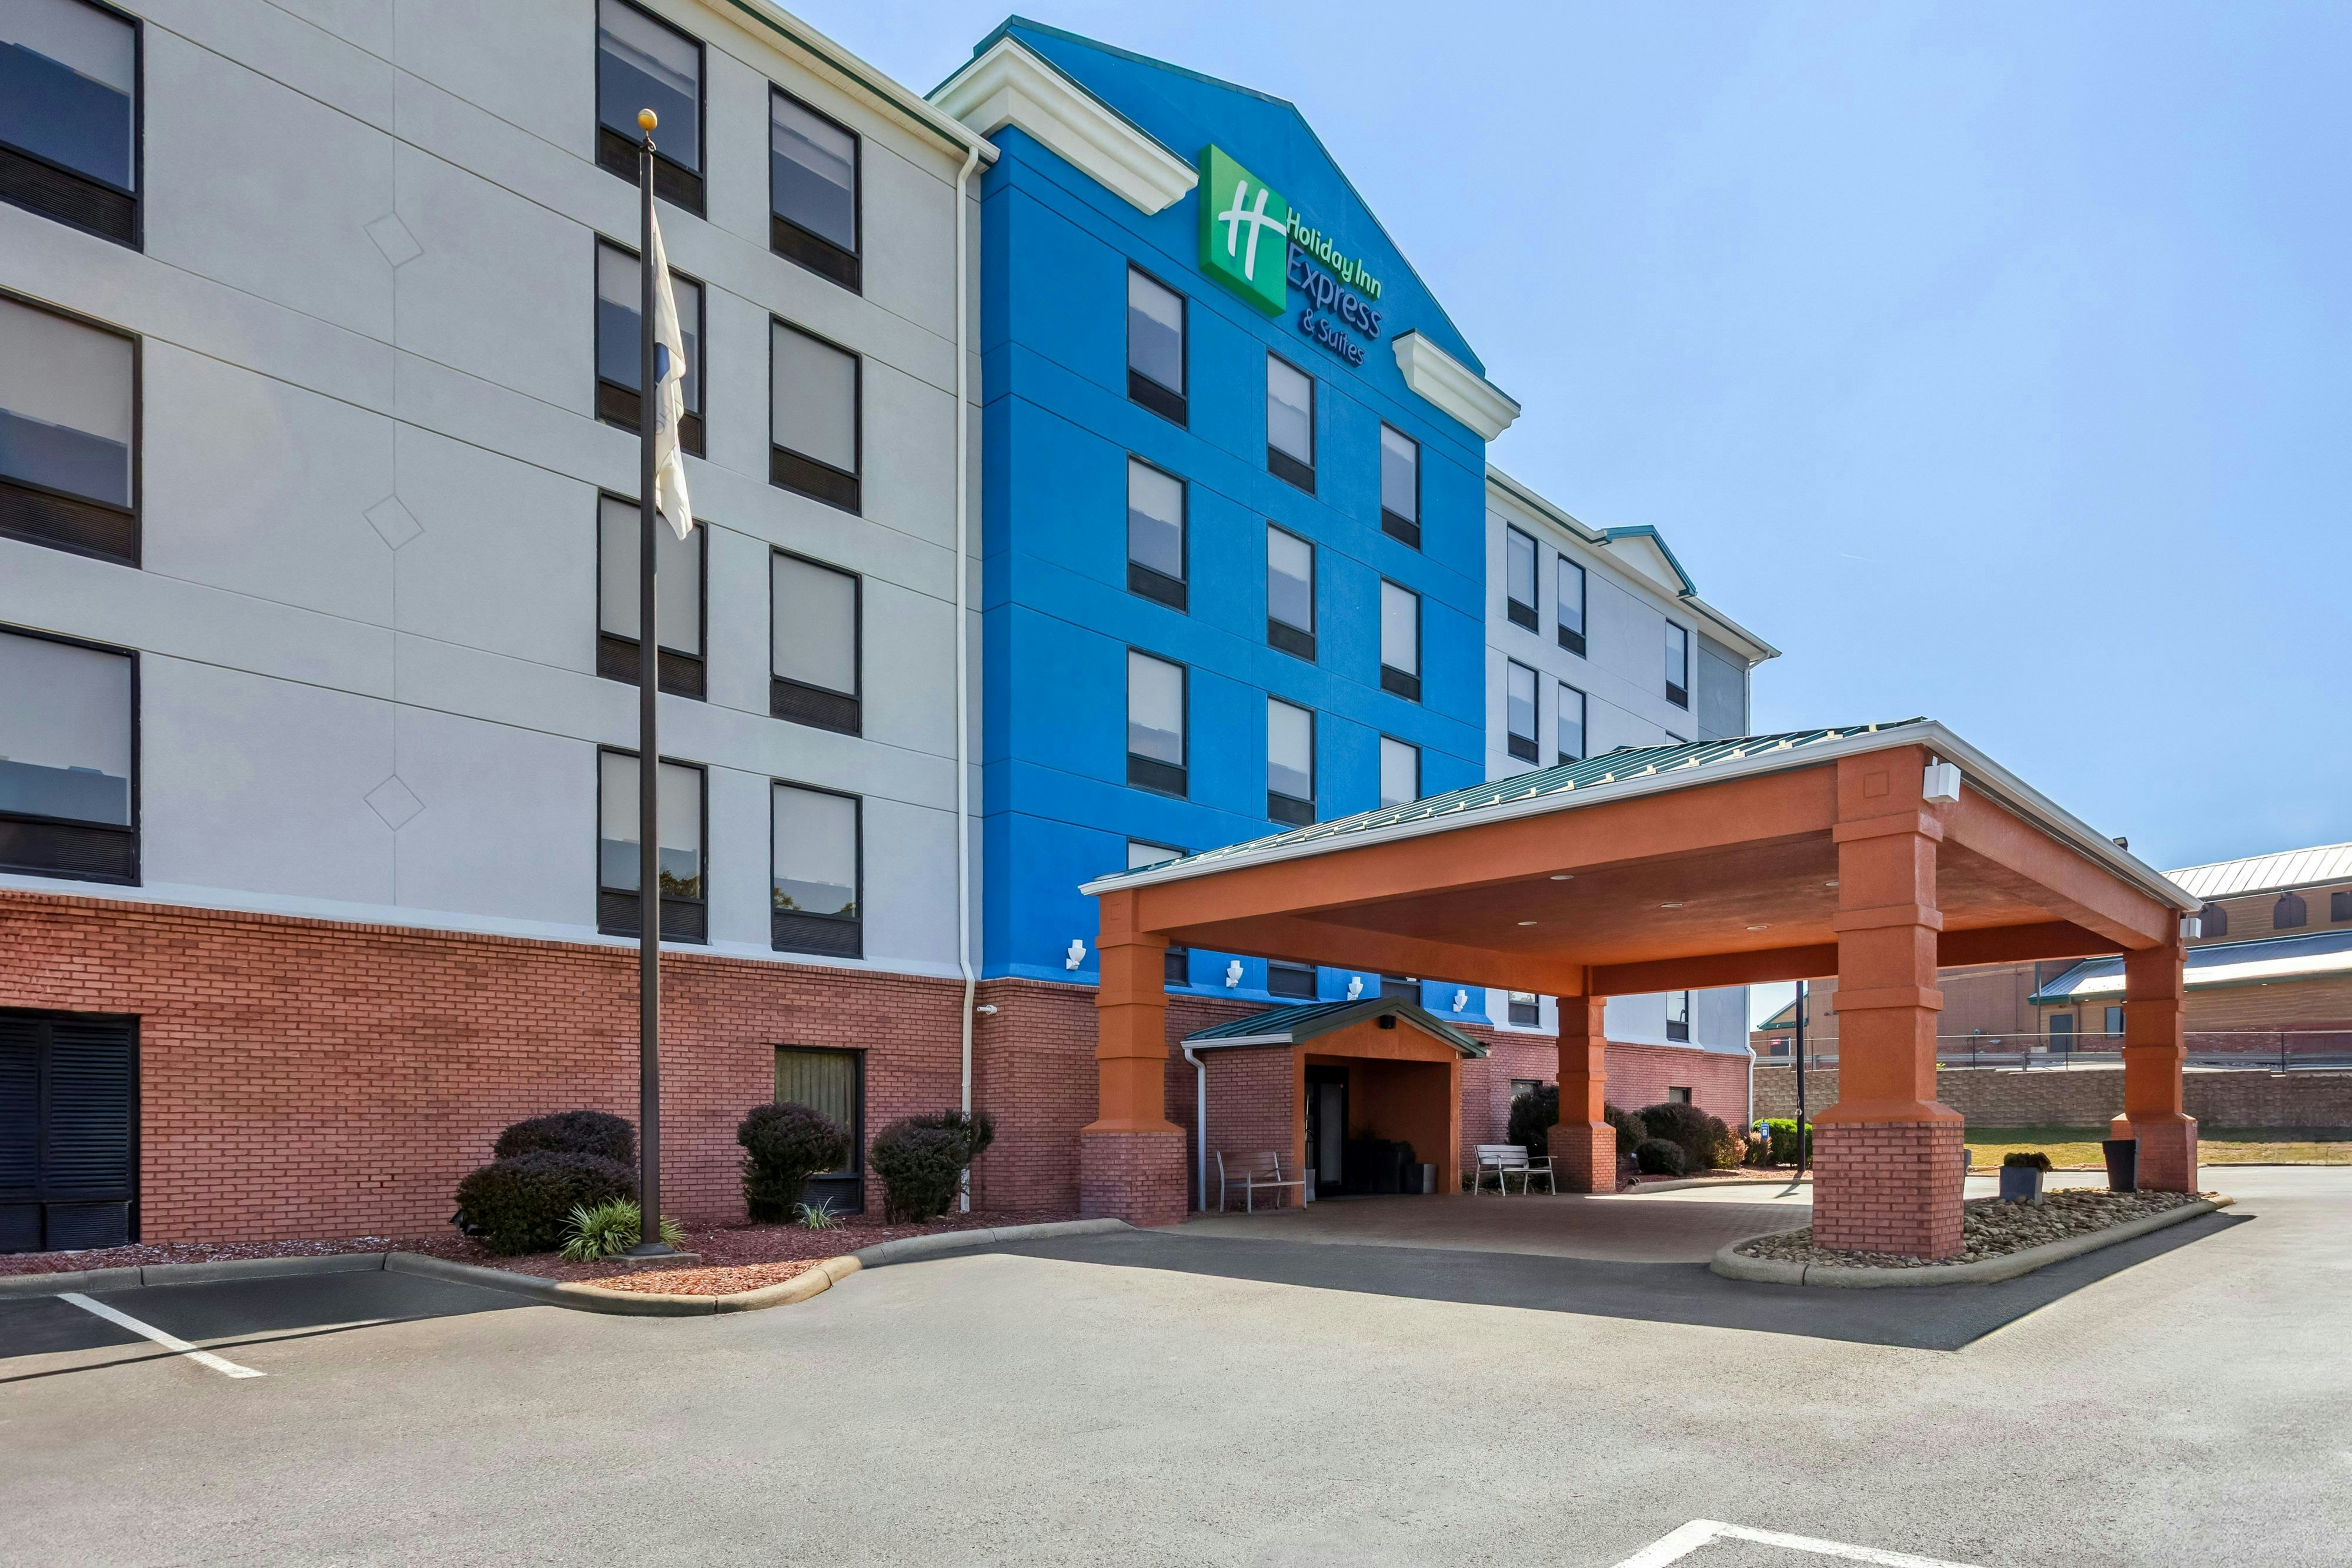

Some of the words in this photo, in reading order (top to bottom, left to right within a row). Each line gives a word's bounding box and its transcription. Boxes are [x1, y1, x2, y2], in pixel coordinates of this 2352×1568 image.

[1287, 206, 1354, 283] Holiday
[1355, 258, 1381, 299] Inn
[1287, 241, 1382, 339] Express
[1303, 307, 1315, 335] &
[1318, 318, 1365, 365] Suites
